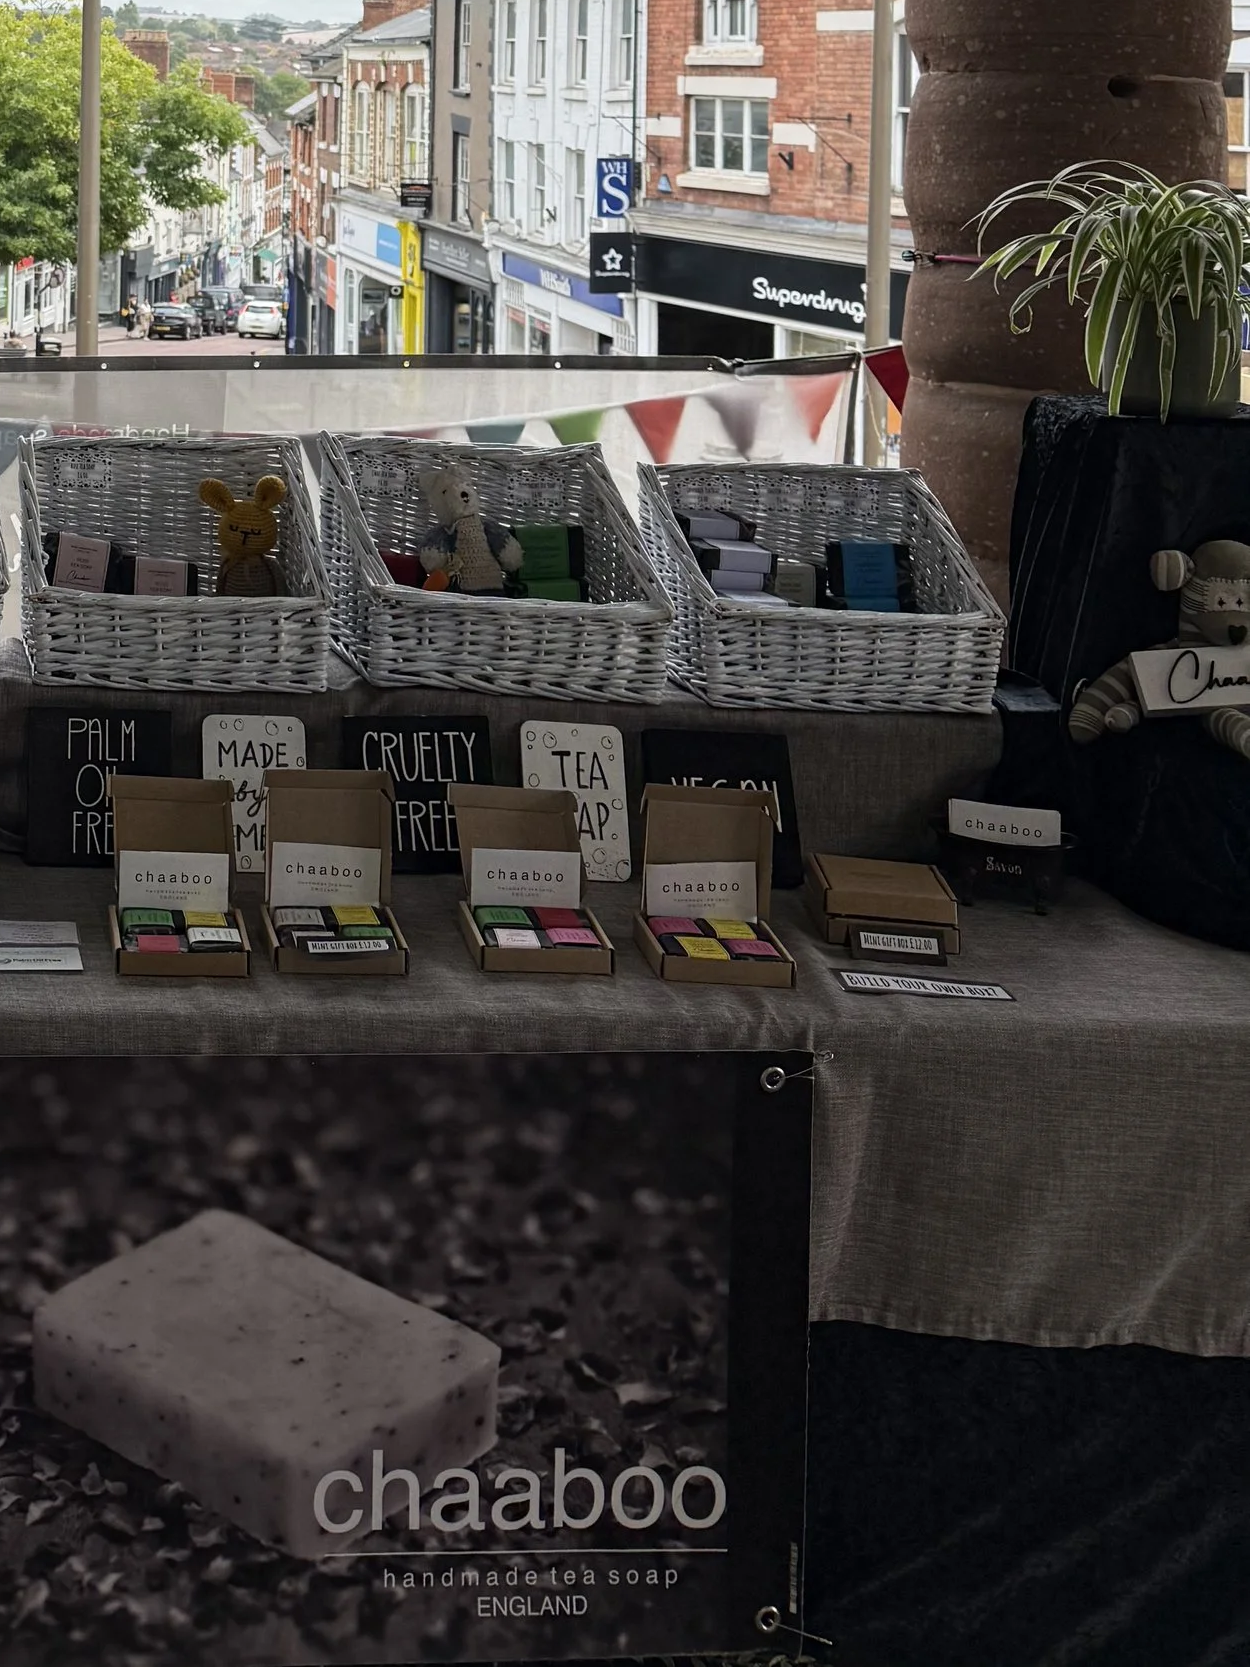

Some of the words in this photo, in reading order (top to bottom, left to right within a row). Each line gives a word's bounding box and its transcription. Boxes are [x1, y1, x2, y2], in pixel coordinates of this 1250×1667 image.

[602, 161, 627, 174] WH
[602, 174, 630, 215] S
[752, 276, 867, 324] Superdrug
[67, 717, 137, 763] PALM
[217, 739, 287, 768] MADE
[360, 730, 477, 784] CRUELTY
[551, 750, 609, 790] TEA
[71, 811, 115, 855] FRE
[394, 800, 461, 852] FREE
[578, 801, 610, 841] AP
[965, 819, 1042, 838] chaaboo
[135, 871, 212, 884] chaaboo
[285, 862, 362, 878] chaaboo
[487, 868, 564, 882] chaaboo
[662, 881, 740, 893] chaaboo
[311, 942, 329, 950] MINI
[359, 941, 382, 949] £12.00
[863, 934, 880, 946] MINI
[881, 937, 897, 947] GIFT
[910, 938, 933, 951] £12.00
[846, 974, 891, 987] BUILD
[891, 978, 930, 991] YOUR
[931, 983, 965, 994] OWN
[313, 1447, 728, 1533] chaaboo
[382, 1565, 539, 1589] handmade
[549, 1565, 598, 1588] tea
[607, 1565, 679, 1591] soap
[475, 1595, 589, 1618] ENGLAND
